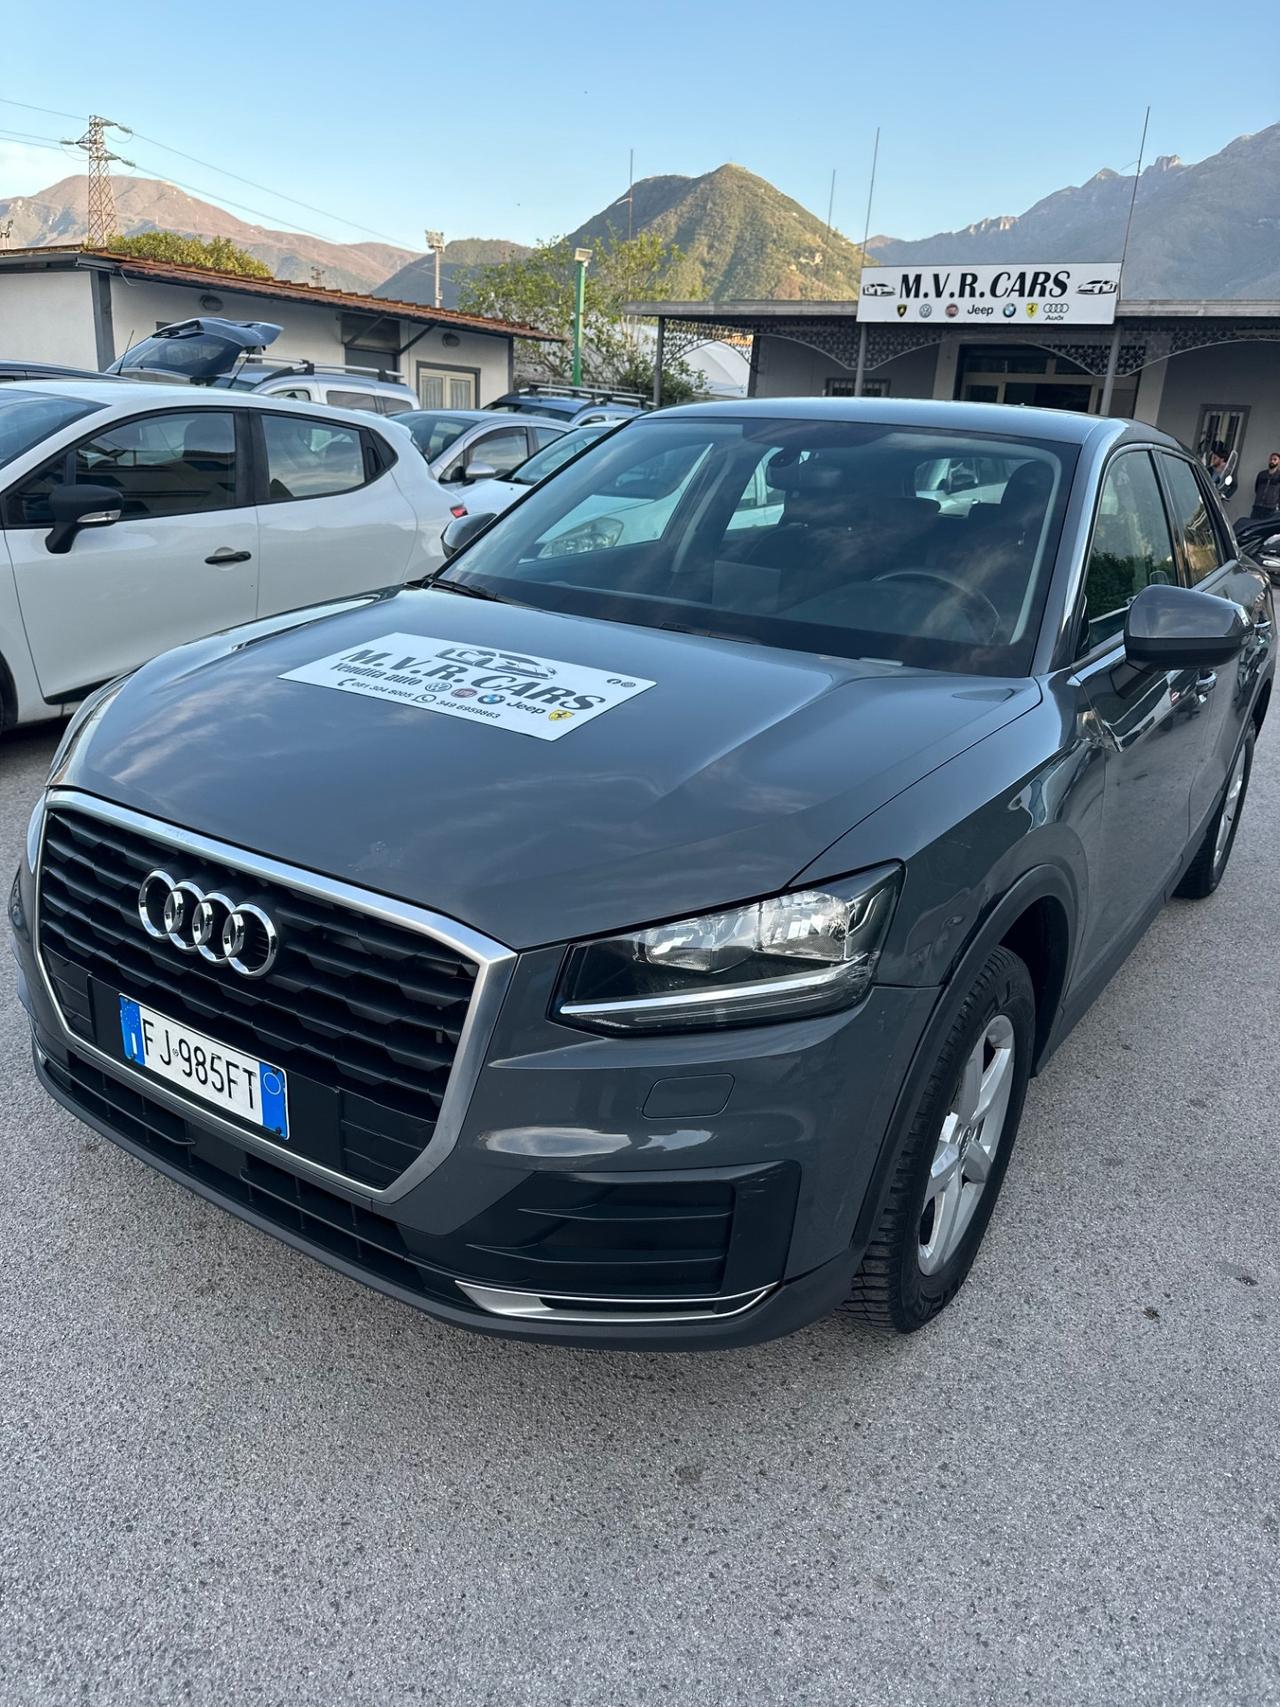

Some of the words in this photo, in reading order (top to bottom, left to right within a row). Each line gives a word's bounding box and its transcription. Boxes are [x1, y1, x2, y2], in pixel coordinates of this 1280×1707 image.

[967, 305, 994, 318] Jeep
[330, 662, 387, 679] Vendita
[384, 673, 423, 686] auto
[436, 700, 457, 708] 349
[506, 701, 546, 715] Jeep
[142, 1018, 257, 1109] FJ985FT
